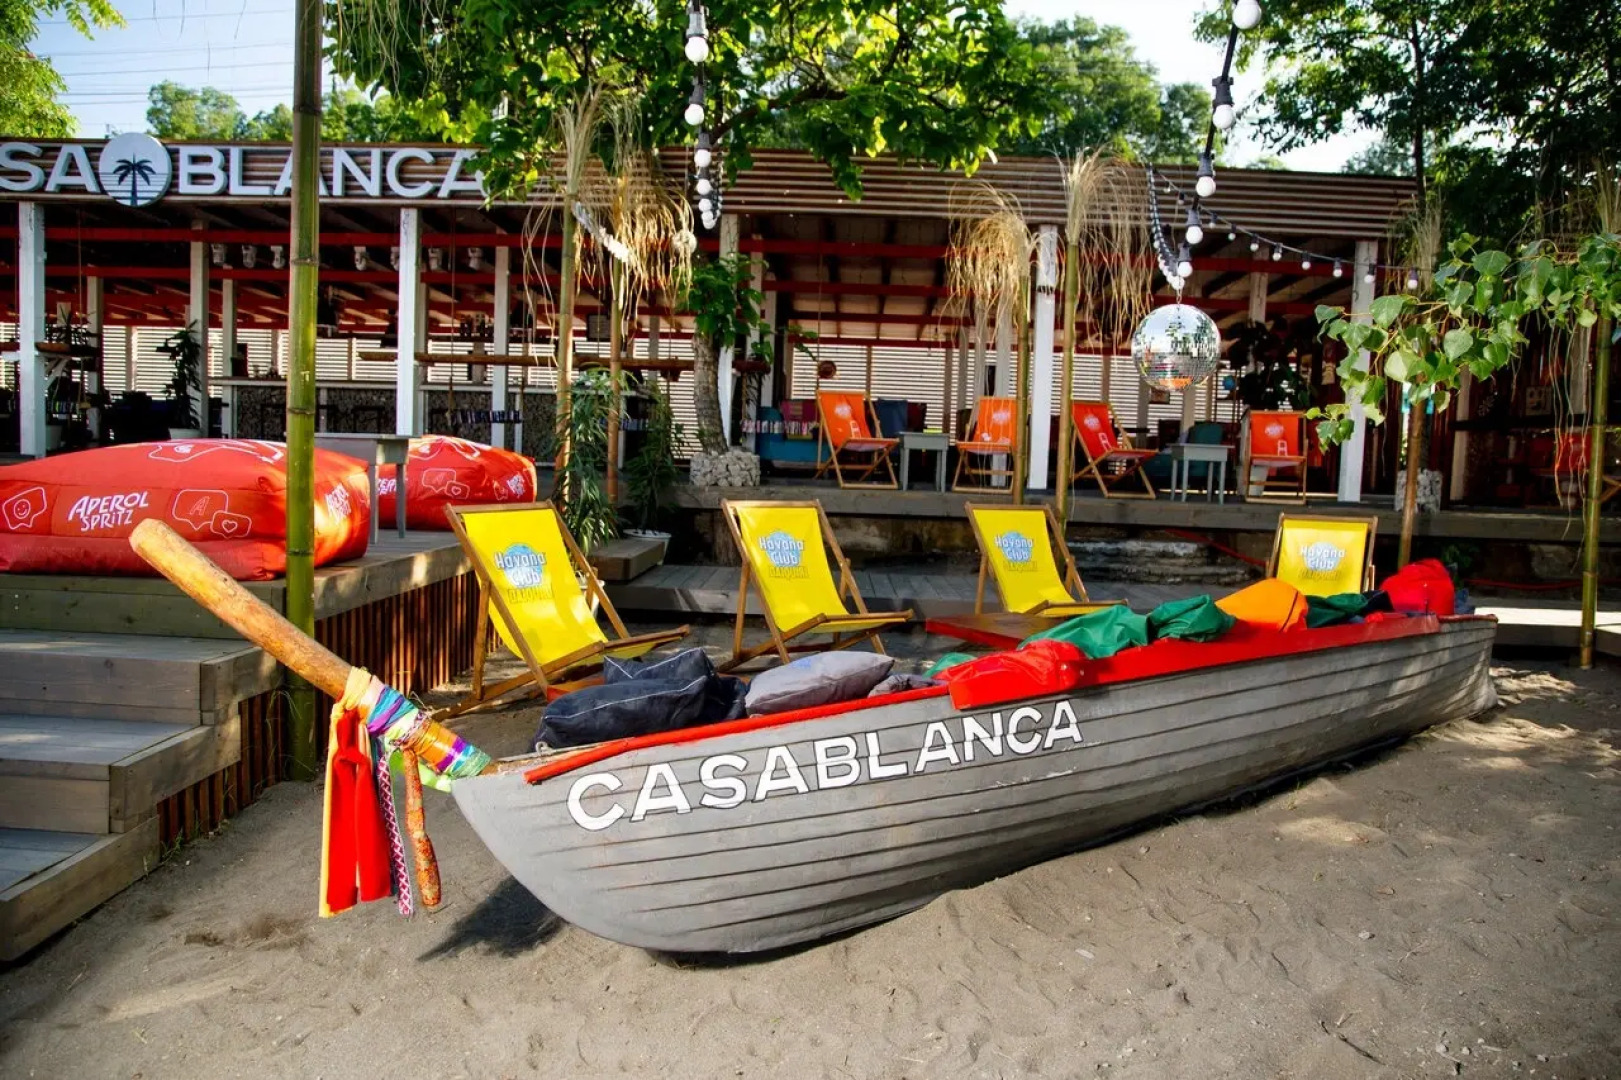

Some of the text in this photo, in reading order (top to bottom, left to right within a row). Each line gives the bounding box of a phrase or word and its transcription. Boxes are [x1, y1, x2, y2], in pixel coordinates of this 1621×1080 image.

[68, 491, 149, 521] APEROL
[759, 536, 805, 552] Havana
[994, 535, 1034, 548] Havana
[770, 551, 799, 566] Club
[1007, 547, 1030, 560] Club
[1300, 546, 1346, 559] Havana
[494, 552, 547, 569] Havana
[1308, 558, 1335, 570] Club
[512, 568, 542, 587] Club
[567, 700, 1083, 831] CASABLANCA
